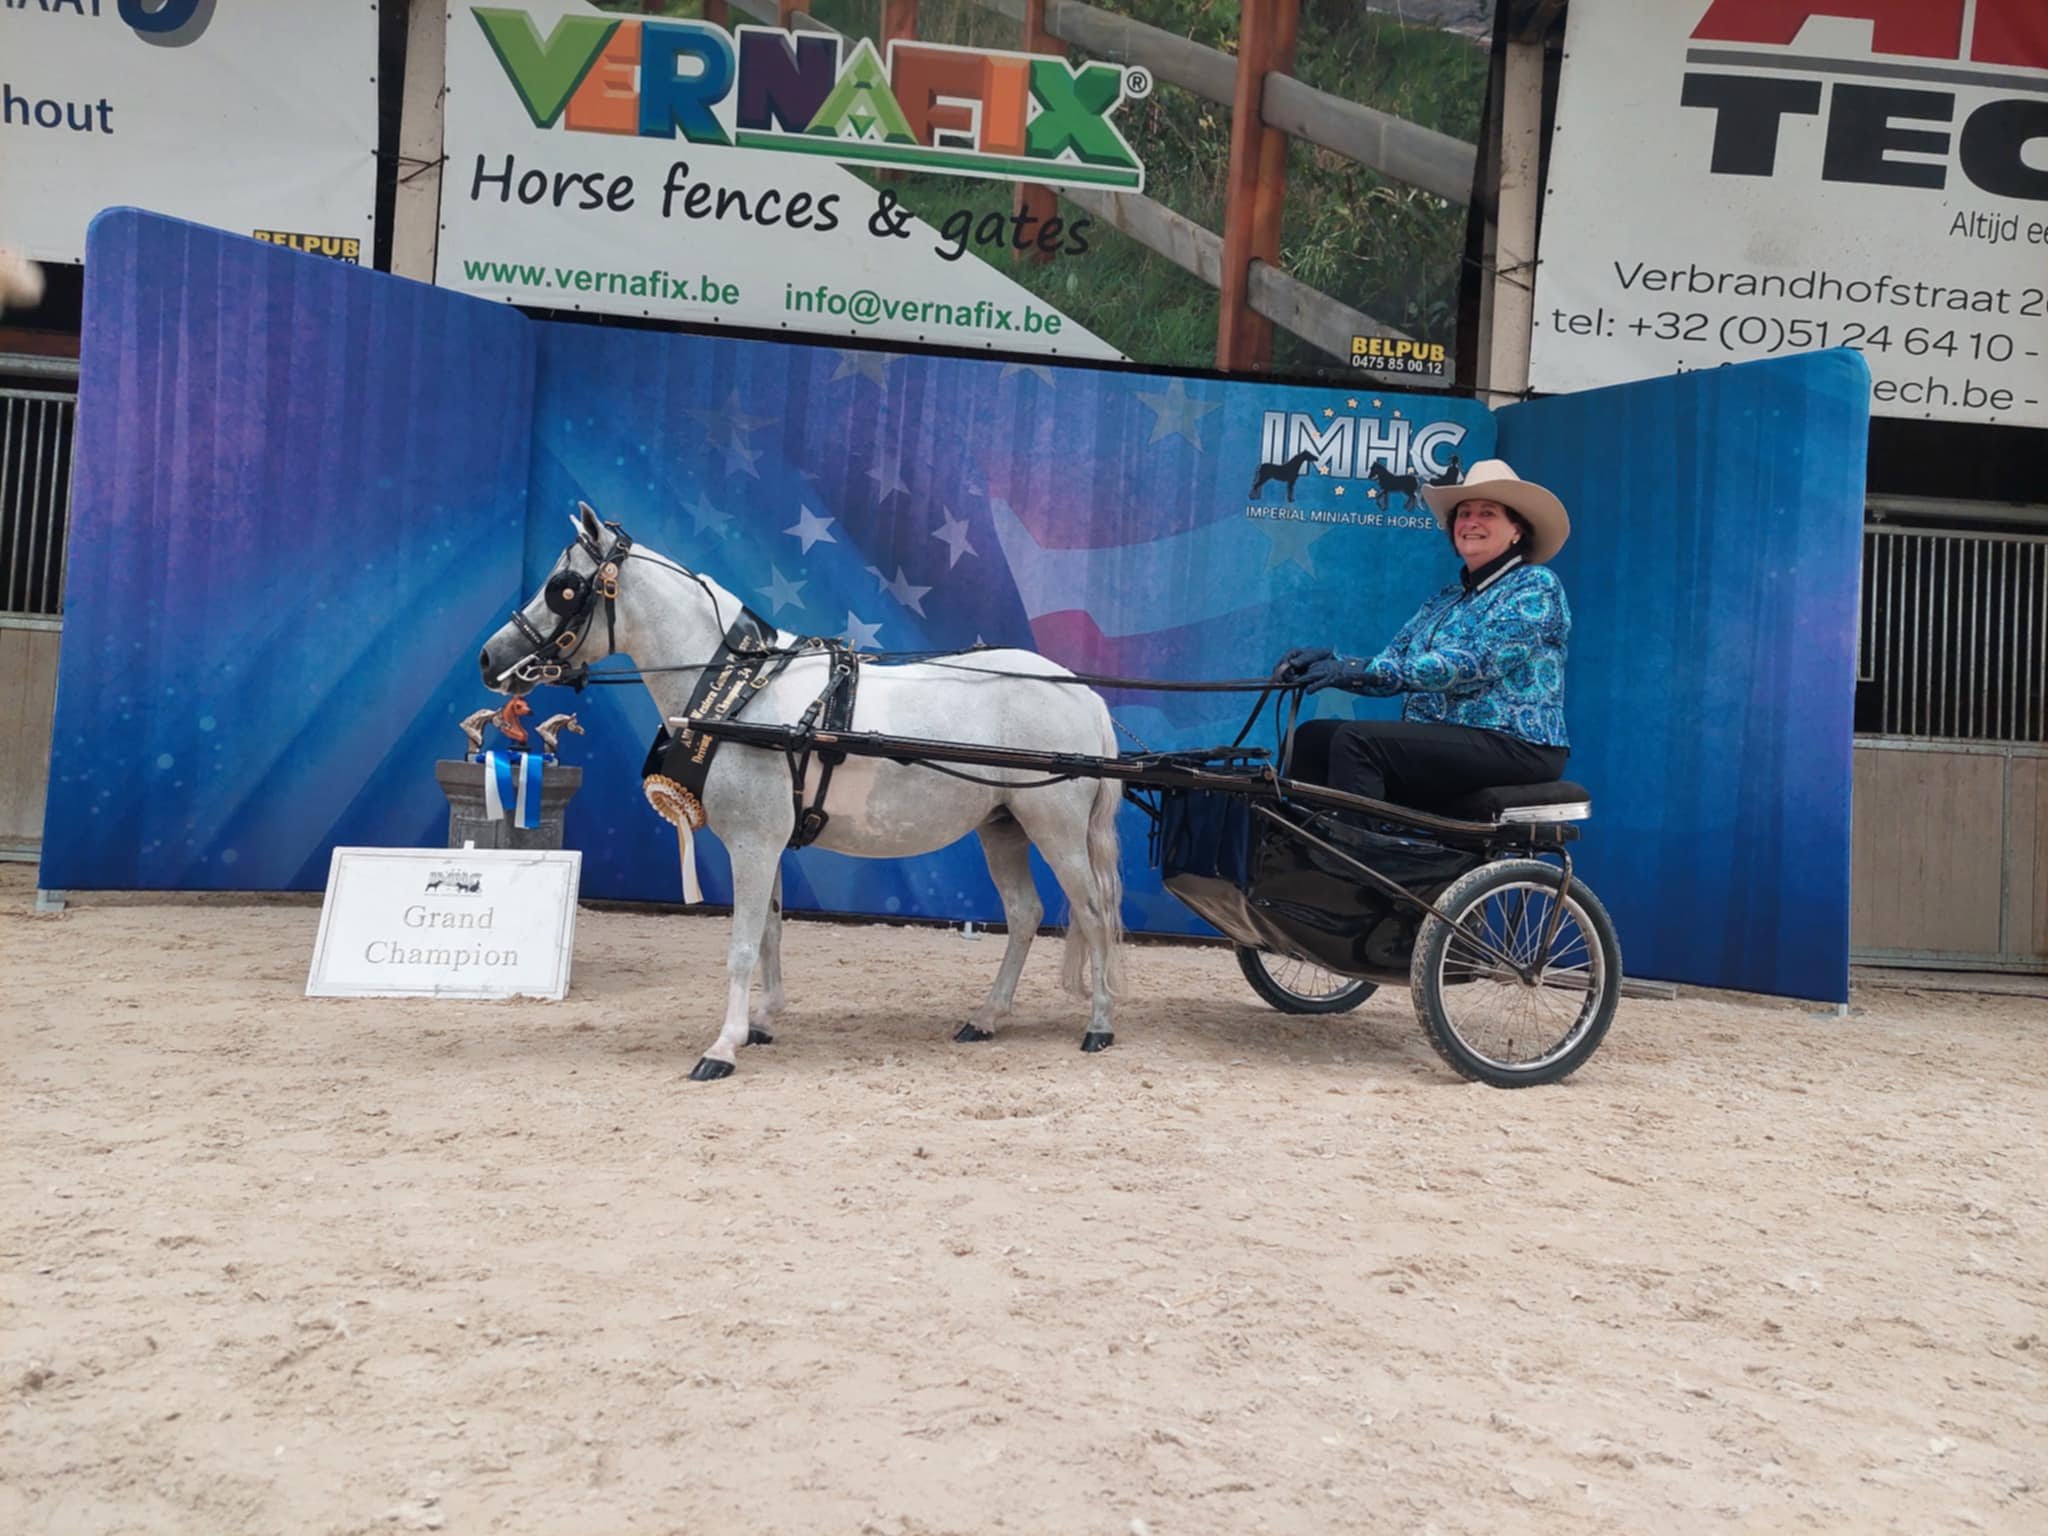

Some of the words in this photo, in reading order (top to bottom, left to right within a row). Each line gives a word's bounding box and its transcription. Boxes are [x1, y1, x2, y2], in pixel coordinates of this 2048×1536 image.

[3, 83, 114, 134] hout
[470, 154, 634, 212] Horse
[661, 161, 840, 232] fences
[867, 191, 914, 238] &
[934, 205, 1090, 261] gates
[1949, 211, 2019, 245] Altijd
[464, 261, 740, 305] www.vernafix.be
[785, 284, 1062, 337] info@vernafix.be
[1613, 261, 2011, 315] Verbrandhofstraat
[1352, 336, 1445, 362] BELPUB
[1552, 308, 1615, 337] tel:
[1628, 312, 1709, 342] +32
[1719, 315, 1828, 353] (0)51
[1840, 321, 1893, 353] 24
[1904, 327, 1959, 358] 64
[1969, 332, 2014, 362] 10
[1352, 354, 1384, 369] 0475
[1387, 357, 1404, 370] 85
[1407, 359, 1423, 372] 00
[1427, 362, 1442, 375] 12
[1260, 410, 1467, 483] IMHC
[1246, 505, 1306, 521] IMPERIAL
[1311, 510, 1382, 527] MINIATURE
[1387, 516, 1433, 530] HORSE
[403, 904, 494, 930] Grand
[364, 940, 519, 972] Champion
